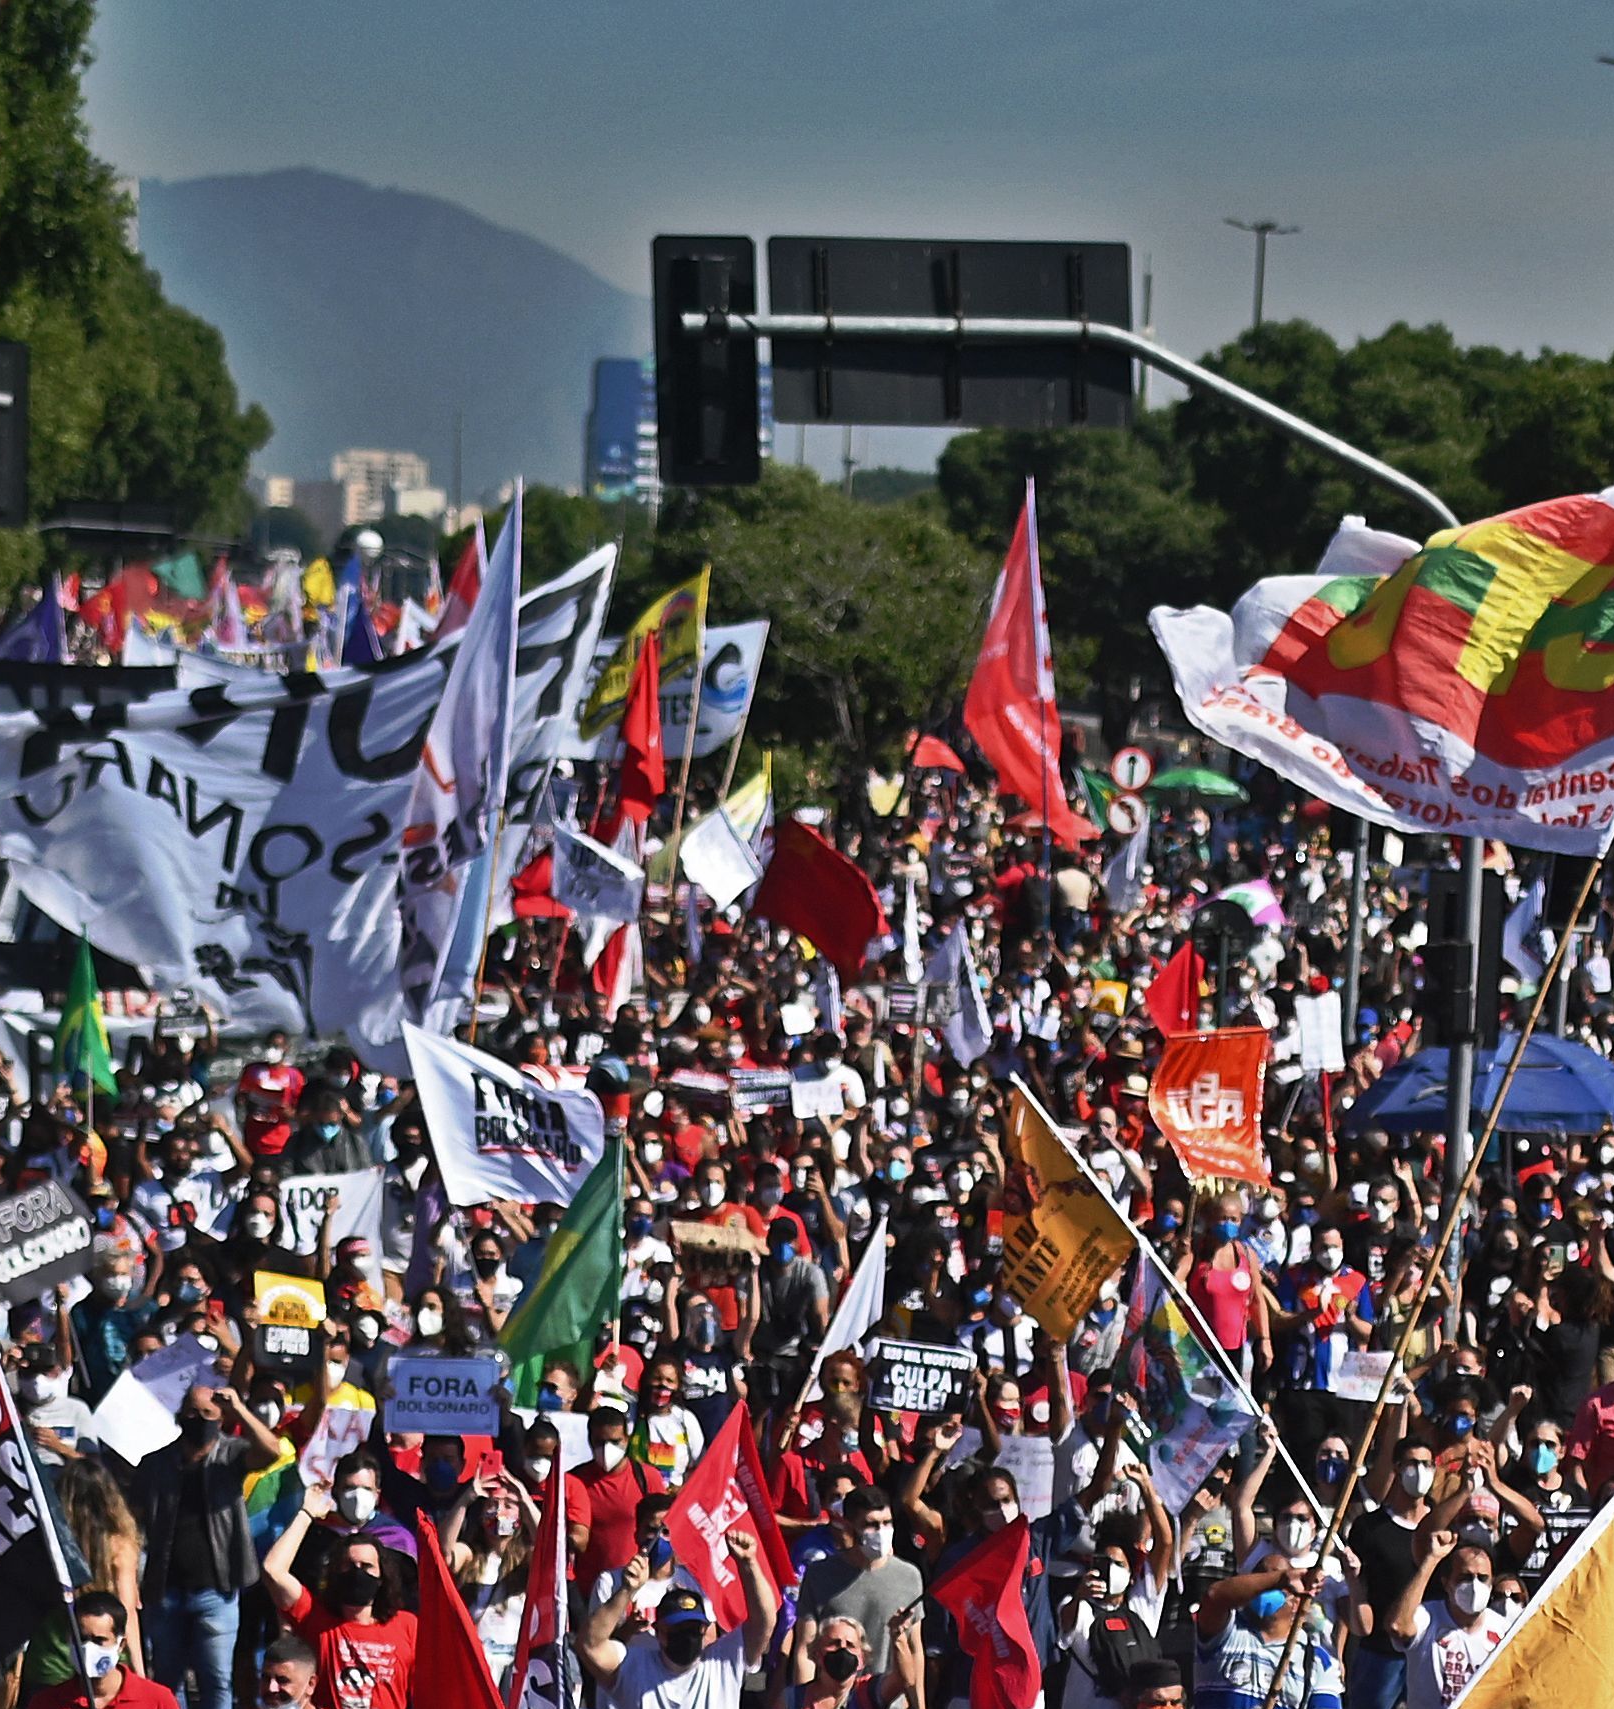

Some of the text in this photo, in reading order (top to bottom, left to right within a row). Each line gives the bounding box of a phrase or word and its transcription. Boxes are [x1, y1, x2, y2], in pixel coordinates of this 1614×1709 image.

[408, 1376, 477, 1398] FORA
[890, 1364, 954, 1393] CULPA
[396, 1400, 491, 1416] BOLSONARO
